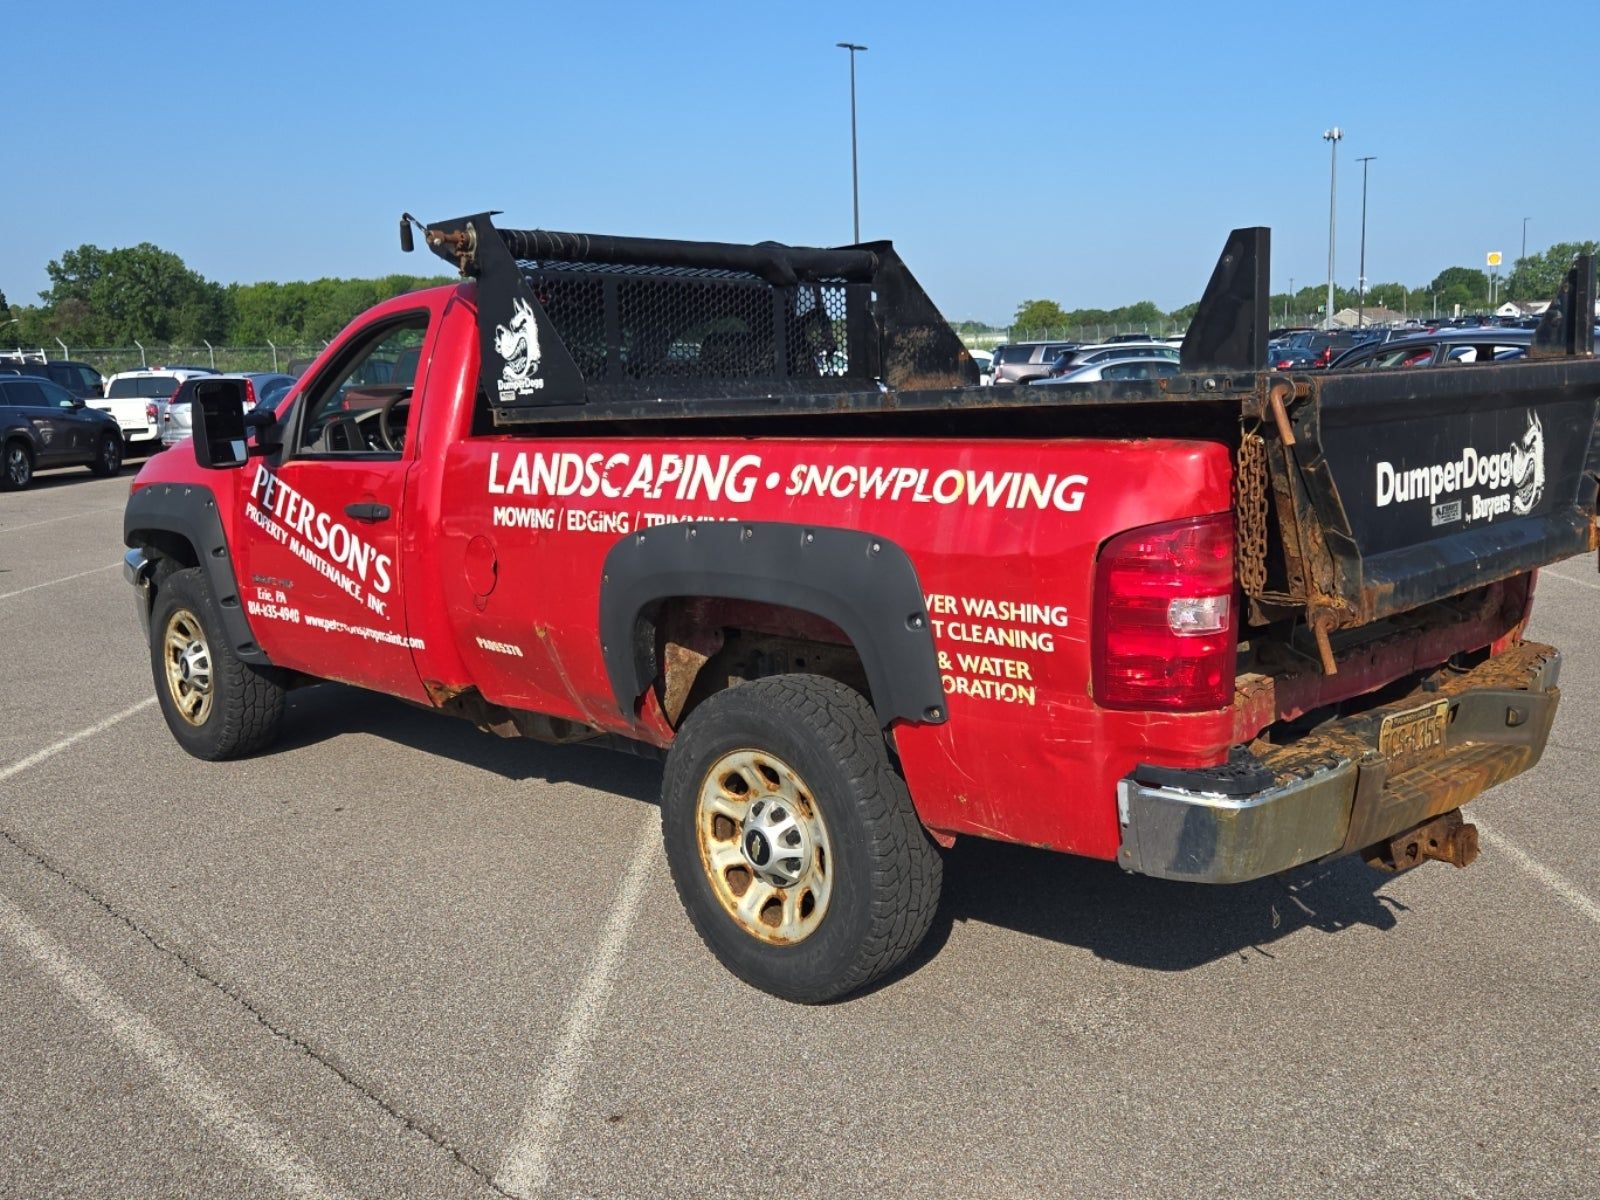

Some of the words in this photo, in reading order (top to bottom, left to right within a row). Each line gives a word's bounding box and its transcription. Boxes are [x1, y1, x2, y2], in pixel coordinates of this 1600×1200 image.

[488, 451, 762, 503] LANDSCAPING
[784, 463, 1089, 512] SNOWPLOWING
[1376, 447, 1512, 508] DumperDogg
[493, 506, 555, 529] MOWING
[1472, 493, 1511, 522] Buyers
[250, 463, 392, 594] PETERSON'S
[245, 502, 288, 545] PROPERTY
[289, 536, 364, 604] MAINTENANCE,
[275, 590, 287, 604] PA
[960, 596, 1069, 627] WASHING
[947, 621, 1055, 652] CLEANING
[937, 650, 954, 671] &
[956, 652, 1033, 681] WATER
